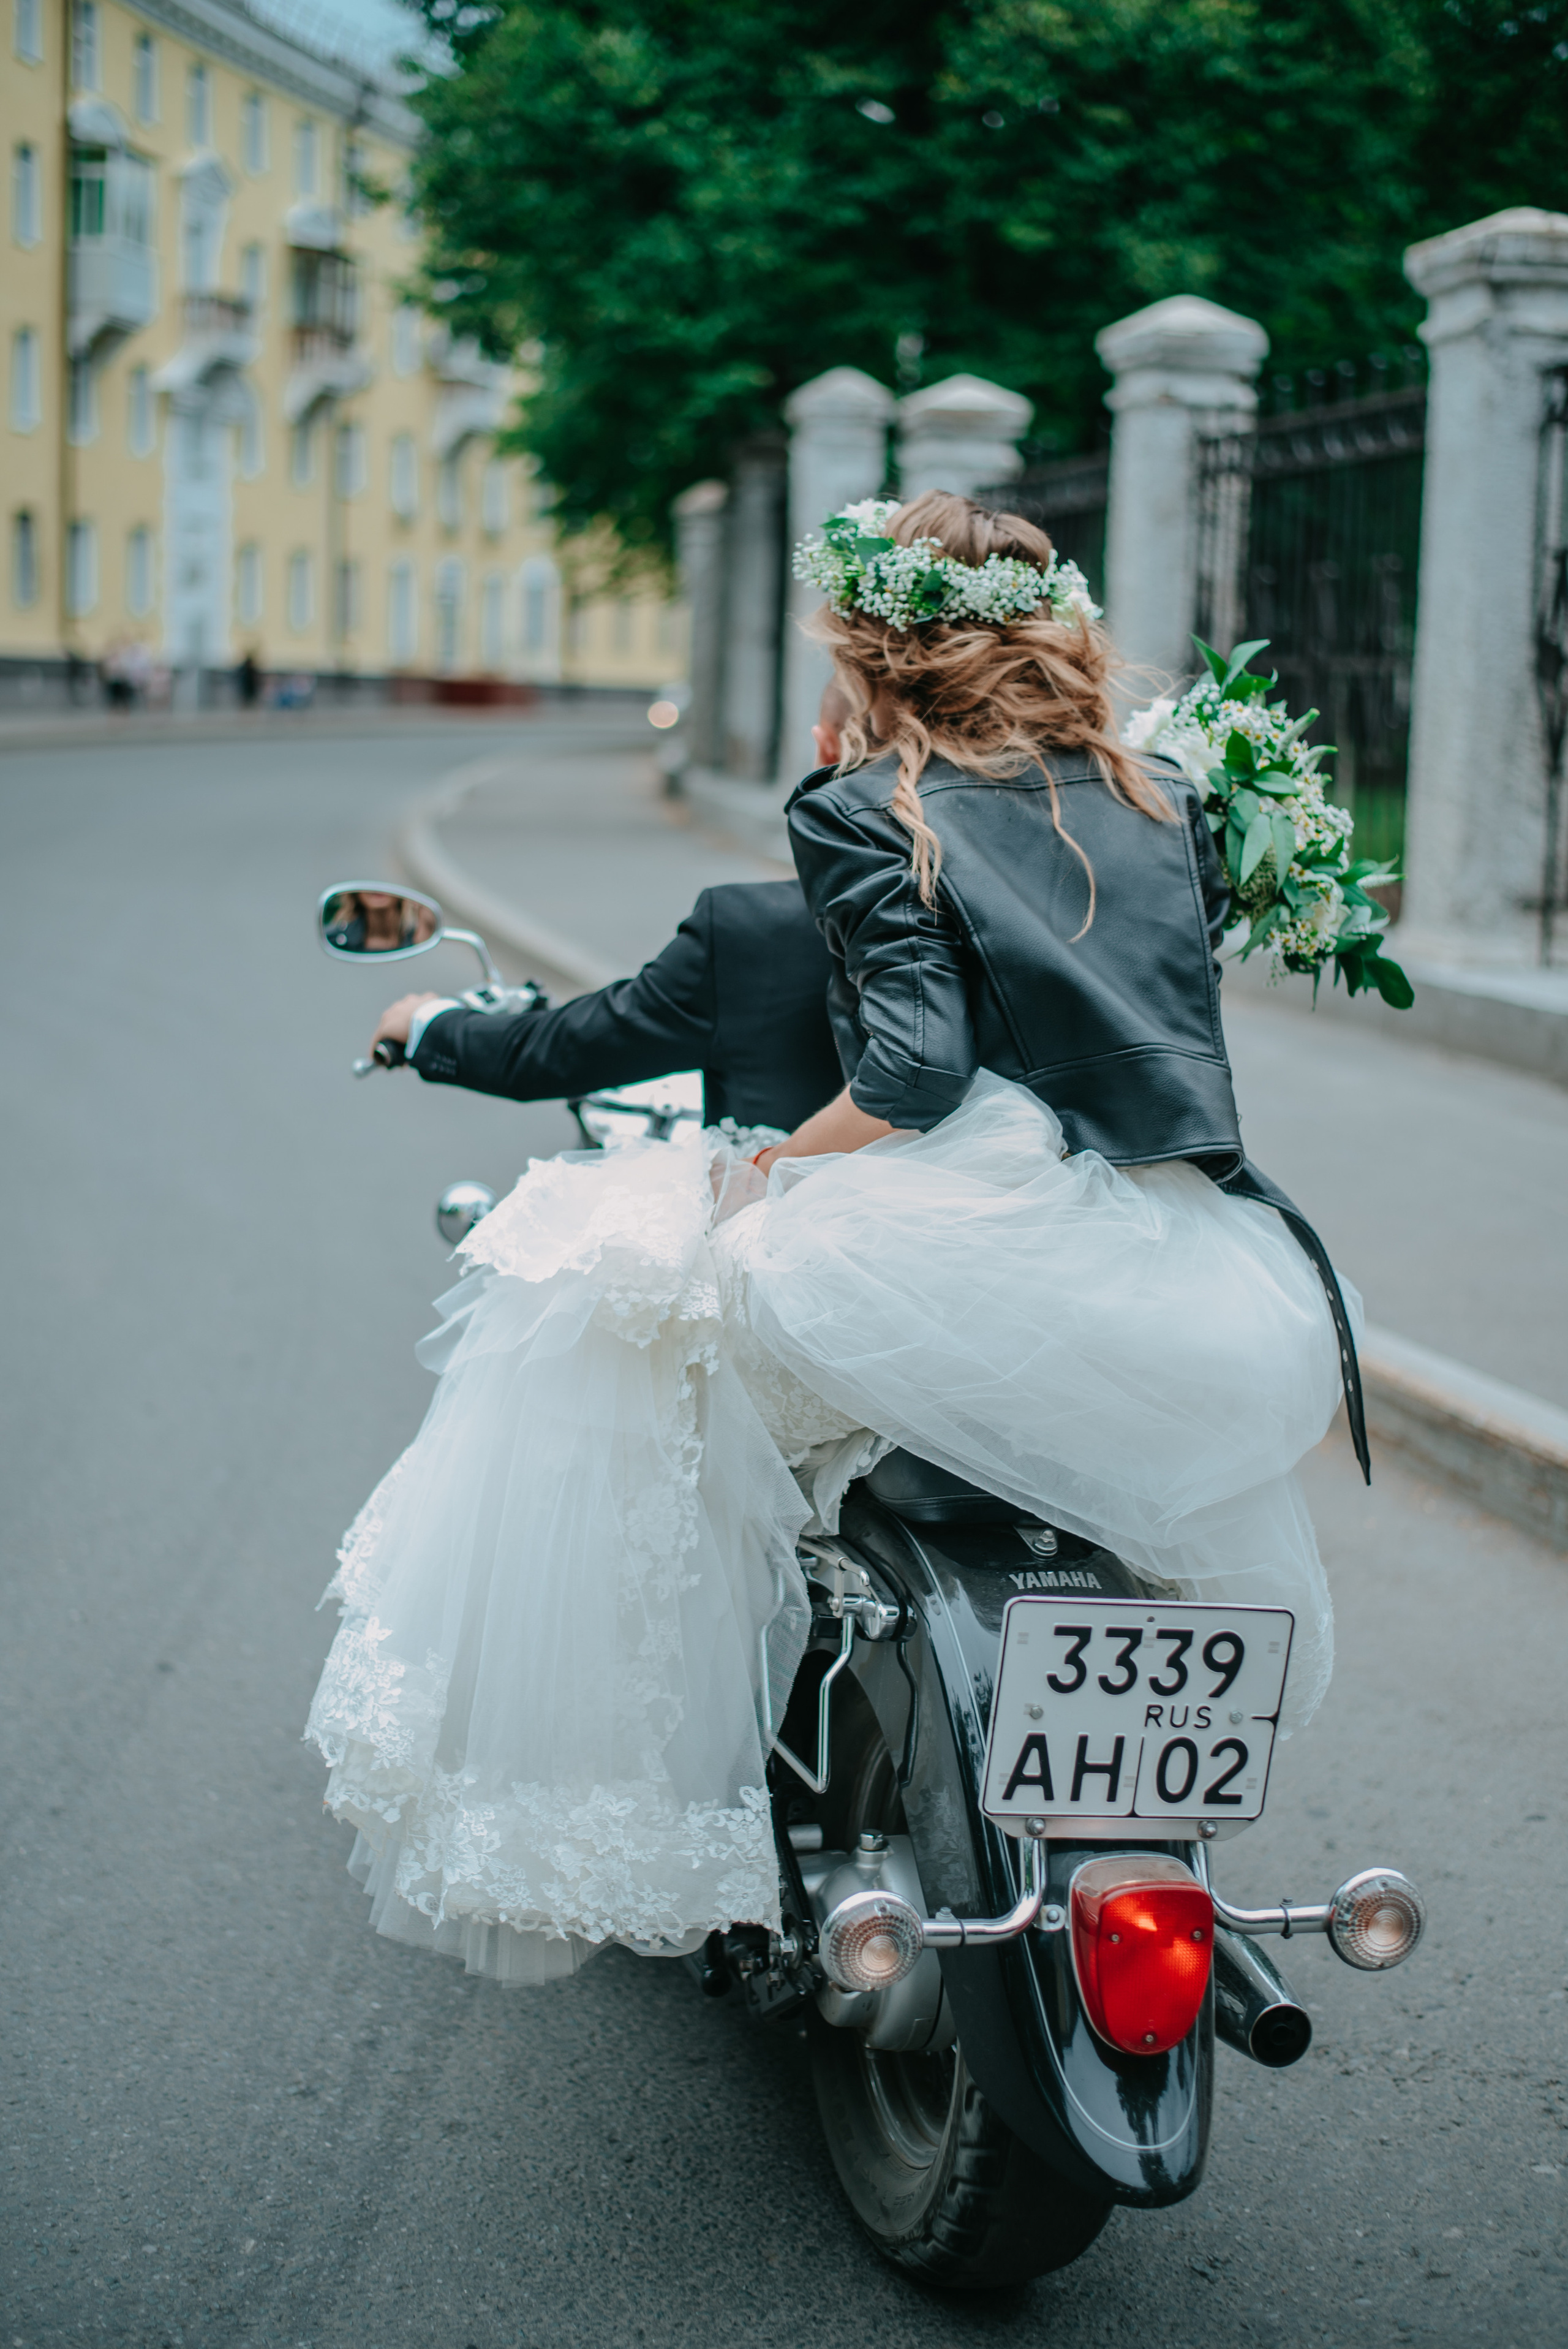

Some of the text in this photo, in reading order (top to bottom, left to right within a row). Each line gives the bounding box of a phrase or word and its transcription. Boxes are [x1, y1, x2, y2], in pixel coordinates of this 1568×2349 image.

[1009, 1570, 1102, 1590] YAMAHA
[1046, 1625, 1246, 1699] 3339
[1144, 1704, 1212, 1730] RUS
[1001, 1733, 1250, 1806] AH 02
